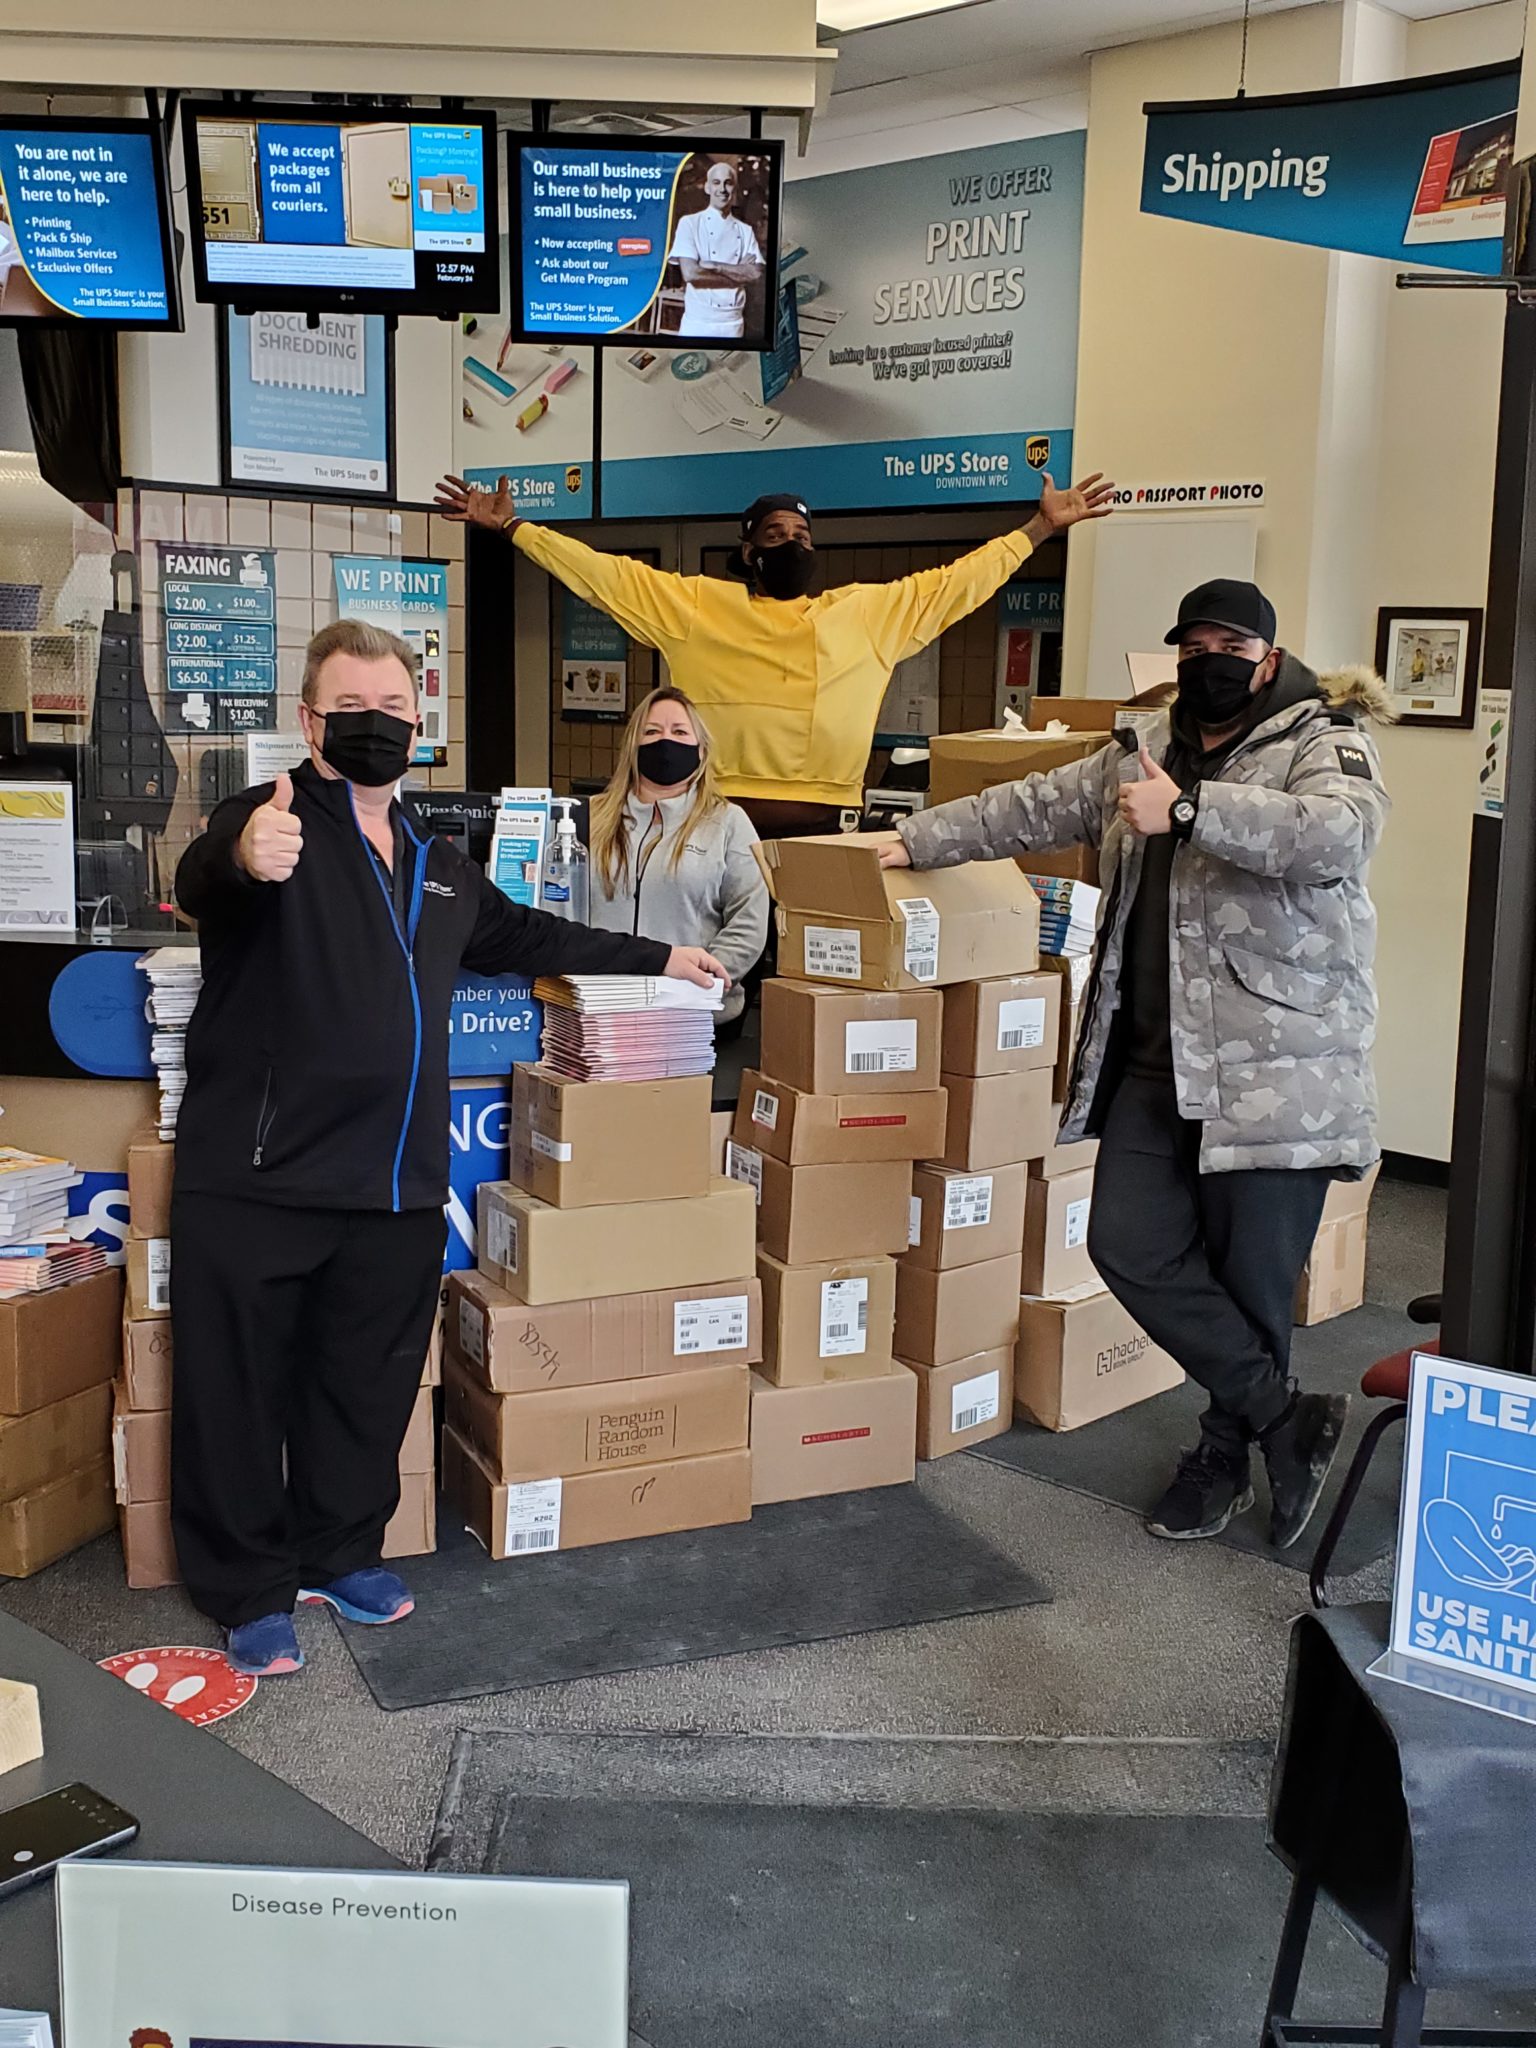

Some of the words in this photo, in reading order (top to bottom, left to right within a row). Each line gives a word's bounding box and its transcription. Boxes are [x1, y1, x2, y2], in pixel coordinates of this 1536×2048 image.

[15, 144, 42, 161] You
[46, 148, 68, 161] are
[72, 147, 95, 162] not
[99, 147, 113, 162] in
[268, 143, 289, 157] We
[292, 144, 335, 161] accept
[18, 165, 29, 181] it
[33, 166, 76, 184] alone,
[79, 171, 101, 183] we
[105, 171, 128, 184] are
[269, 162, 330, 178] packages
[533, 160, 558, 176] Our
[562, 161, 599, 178] small
[603, 162, 661, 179] business
[1162, 146, 1330, 202] Shipping
[271, 180, 301, 194] from
[304, 181, 321, 194] all
[534, 181, 545, 197] is
[548, 182, 580, 198] here
[584, 183, 598, 198] to
[601, 184, 632, 203] help
[636, 187, 666, 203] your
[950, 174, 982, 205] WE
[986, 165, 1052, 199] OFFER
[21, 187, 53, 202] here
[57, 188, 71, 203] to
[75, 188, 110, 207] help.
[272, 199, 328, 213] couriers.
[534, 203, 571, 218] small
[574, 203, 637, 220] business.
[32, 217, 72, 231] Printing
[34, 232, 58, 243] Pack
[60, 233, 68, 243] &
[69, 233, 92, 246] Ship
[926, 209, 1031, 264] PRINT
[542, 238, 564, 249] Now
[566, 239, 613, 253] accepting
[36, 248, 76, 259] Mailbox
[77, 249, 118, 260] Services
[38, 262, 82, 273] Exclusive
[83, 263, 113, 274] Offers
[460, 264, 475, 274] PM
[542, 258, 560, 269] Ask
[563, 258, 589, 270] about
[592, 261, 609, 270] our
[437, 274, 465, 283] February
[541, 273, 558, 283] Get
[560, 273, 585, 284] More
[588, 274, 628, 287] Program
[80, 288, 94, 298] The
[96, 289, 112, 298] UPS
[139, 289, 145, 298] is
[147, 290, 164, 301] your
[872, 266, 1026, 324] SERVICES
[73, 297, 95, 307] Small
[96, 298, 130, 308] Business
[131, 298, 165, 309] Solution.
[530, 302, 544, 311] The
[546, 302, 562, 312] UPS
[588, 303, 595, 312] is
[597, 305, 614, 315] your
[530, 312, 552, 322] Small
[553, 312, 587, 322] Business
[588, 312, 622, 324] Solution.
[258, 332, 357, 361] SHREDDING
[829, 347, 864, 366] Looking
[865, 344, 878, 362] for
[888, 341, 931, 360] customer
[932, 334, 971, 354] focused
[972, 331, 1013, 350] printer?
[873, 359, 907, 380] We've
[909, 356, 930, 381] got
[931, 357, 955, 378] you
[957, 350, 1012, 373] covered!
[1027, 446, 1049, 466] ups
[884, 454, 915, 477] The
[920, 452, 955, 475] UPS
[960, 451, 1010, 473] Store
[314, 467, 329, 477] The
[330, 468, 346, 479] UPS
[347, 470, 367, 481] Store
[523, 478, 556, 496] Store
[566, 476, 581, 491] ups
[935, 475, 986, 490] DOWNTOWN
[988, 474, 1008, 488] WPG
[1103, 489, 1132, 504] RO
[1136, 486, 1206, 503] PASSPORT
[1210, 483, 1263, 500] PHOTO
[541, 497, 555, 508] WPG
[165, 554, 231, 577] FAXING
[168, 583, 190, 593] LOCAL
[341, 568, 370, 591] WE
[379, 570, 441, 595] PRINT
[175, 597, 206, 611] $2.00
[233, 597, 256, 608] $1.00
[348, 598, 398, 612] BUSINESS
[401, 600, 436, 613] CARDS
[1006, 592, 1031, 611] WE
[1038, 592, 1064, 611] PR
[169, 621, 189, 631] LONG
[190, 622, 222, 632] DISTANCE
[176, 634, 207, 648] $2.00
[234, 634, 256, 645] $1.25
[170, 658, 225, 669] INTERNATIONAL
[177, 671, 208, 685] $6.50
[234, 670, 257, 680] $1.50
[219, 698, 233, 707] FAX
[234, 699, 268, 708] RECEIVING
[230, 709, 256, 720] $1.00
[255, 742, 294, 751] Shipment
[1342, 748, 1364, 763] HH
[830, 944, 842, 952] EAN
[499, 987, 532, 1005] your
[462, 1011, 534, 1034] Drive?
[1431, 1378, 1536, 1436] PLE
[599, 1407, 665, 1430] Penguin
[598, 1424, 664, 1445] Random
[597, 1441, 648, 1461] House
[1417, 1591, 1491, 1636] USE
[159, 1650, 222, 1662] STAND
[231, 1891, 325, 1918] Disease
[332, 1897, 459, 1923] Prevention
